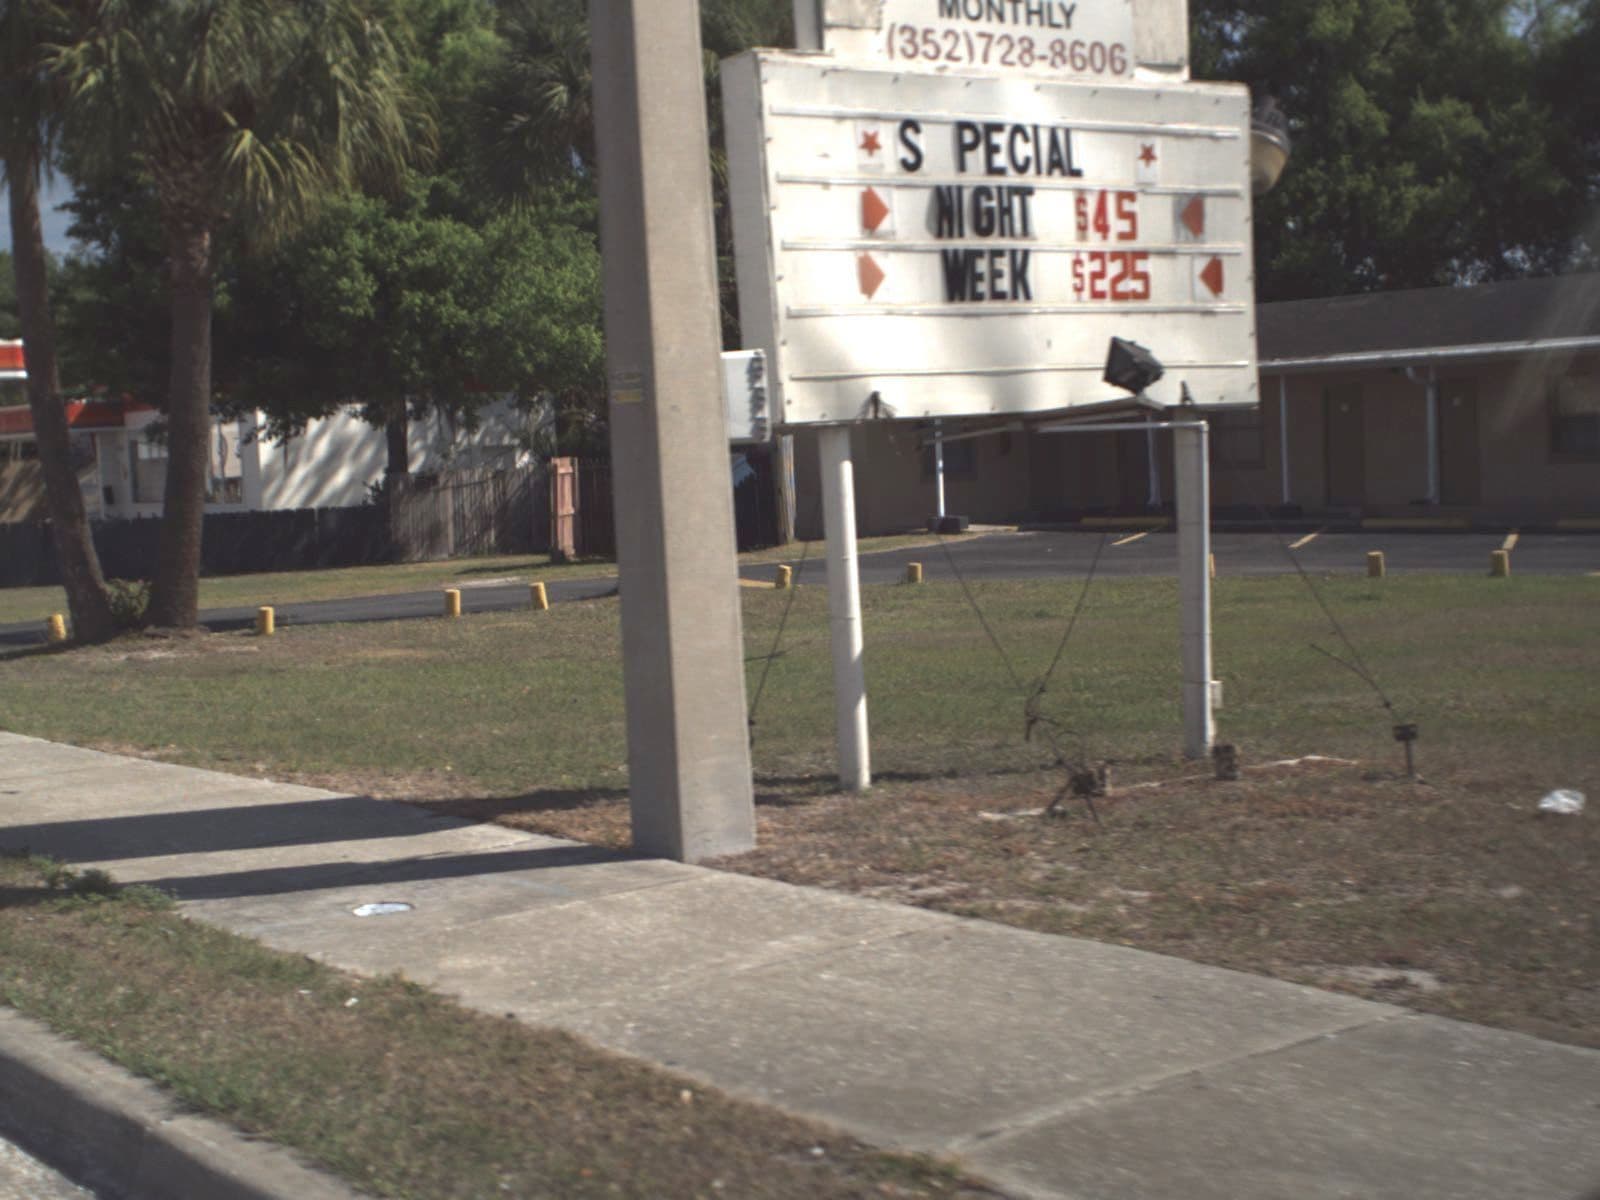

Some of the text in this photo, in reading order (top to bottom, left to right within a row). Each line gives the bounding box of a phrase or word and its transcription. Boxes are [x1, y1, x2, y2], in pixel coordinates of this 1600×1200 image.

[938, 0, 1077, 28] MONTHLY
[886, 23, 1128, 76] (352)728-8606
[935, 185, 1138, 241] NIGHT $45
[941, 249, 1152, 301] WEEK $225
